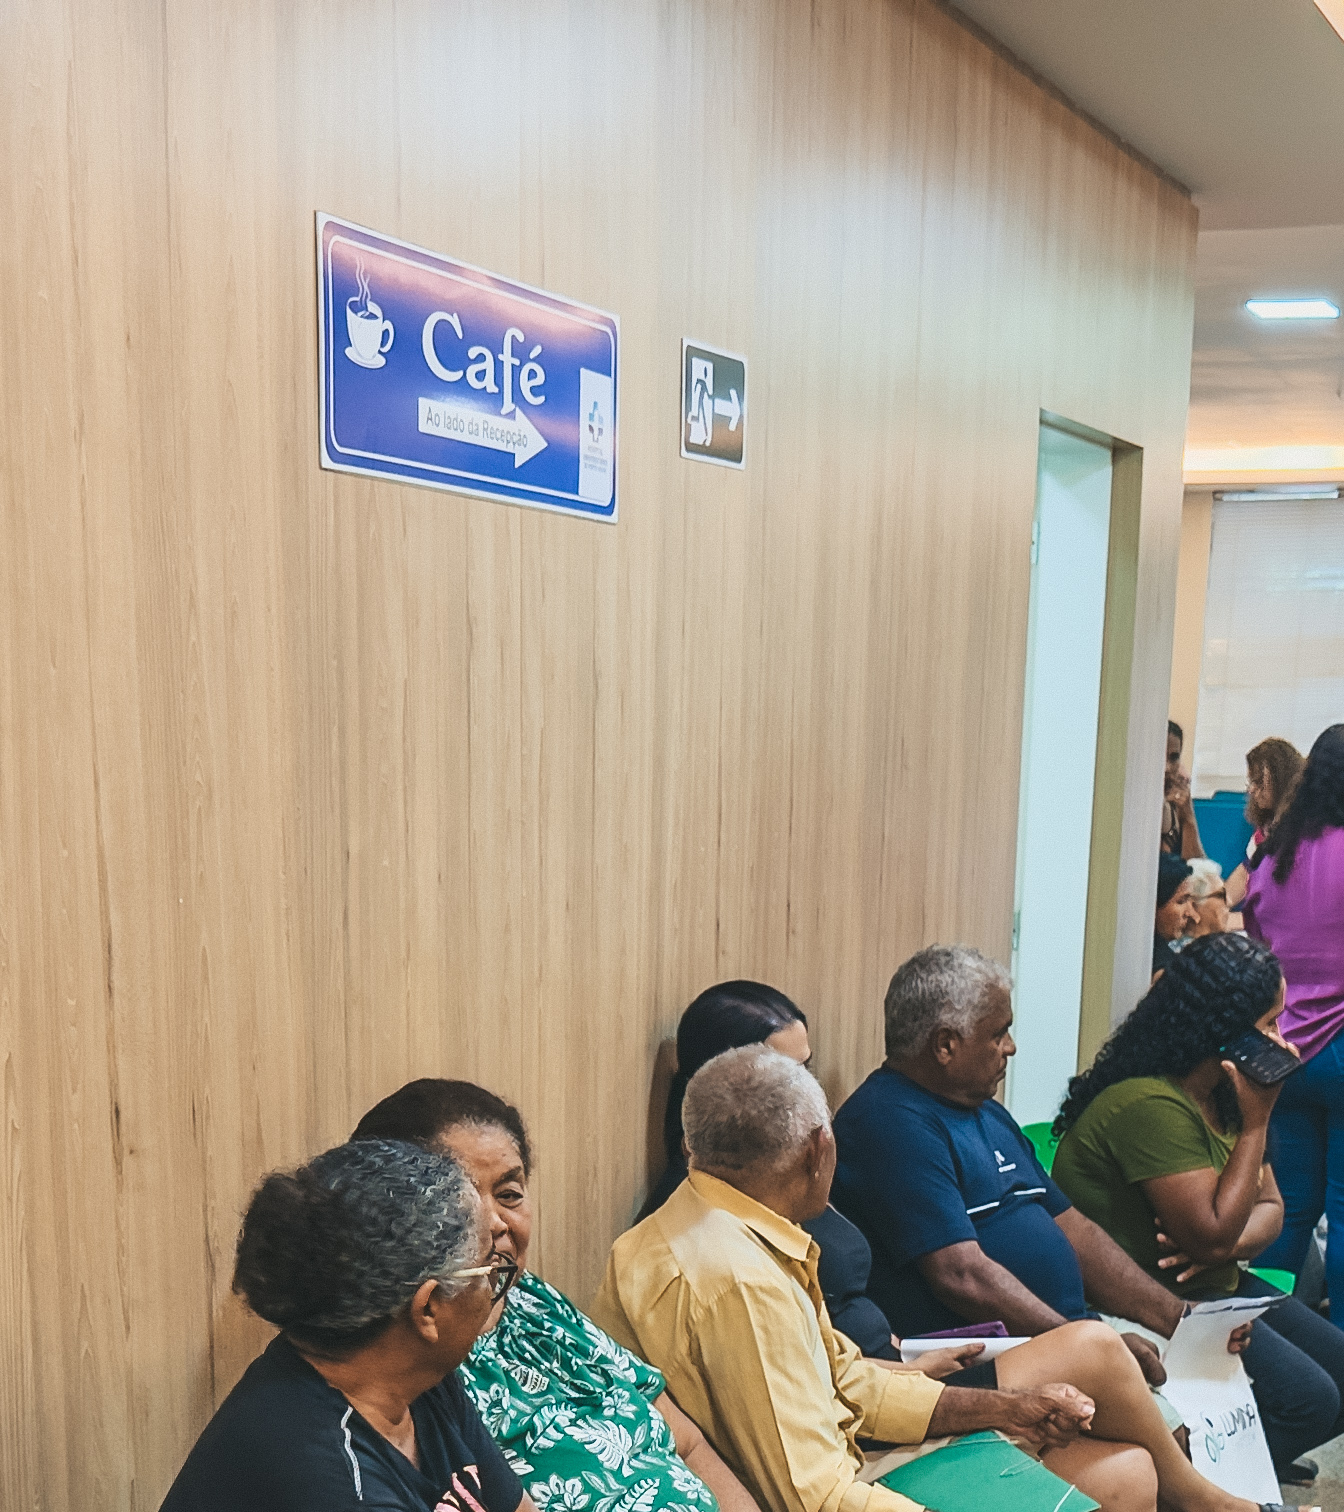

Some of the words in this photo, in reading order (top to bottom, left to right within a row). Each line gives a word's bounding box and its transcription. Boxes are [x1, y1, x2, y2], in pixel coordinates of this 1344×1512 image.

[422, 310, 546, 415] Café
[426, 406, 441, 427] Ao
[443, 411, 465, 435] lado
[467, 419, 480, 437] da
[482, 420, 528, 449] Recepção
